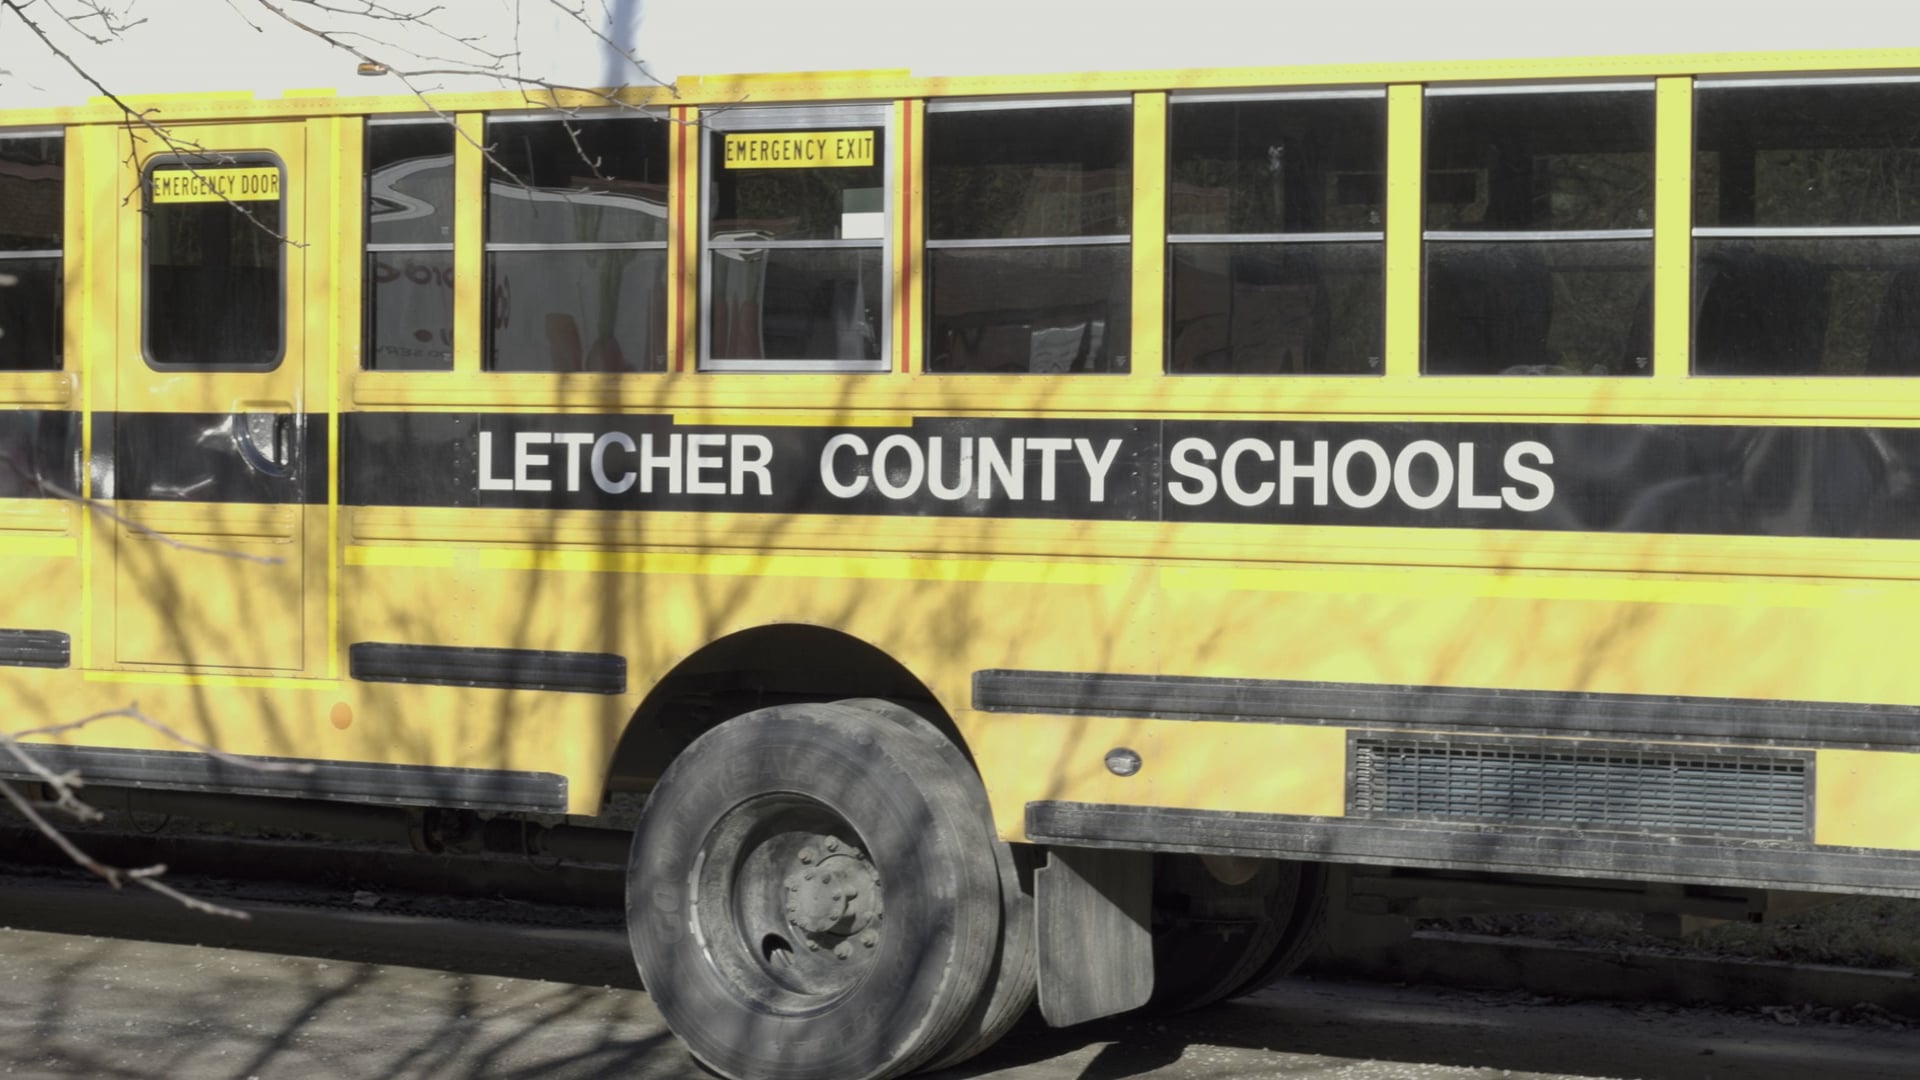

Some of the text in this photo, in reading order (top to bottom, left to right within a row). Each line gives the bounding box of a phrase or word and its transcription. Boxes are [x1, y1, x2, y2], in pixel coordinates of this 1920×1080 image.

[727, 138, 872, 161] EMERGENCY EXIT
[154, 174, 279, 196] EMERGENCY DOOR
[478, 430, 1555, 513] LETCHER COUNTY SCHOOLS
